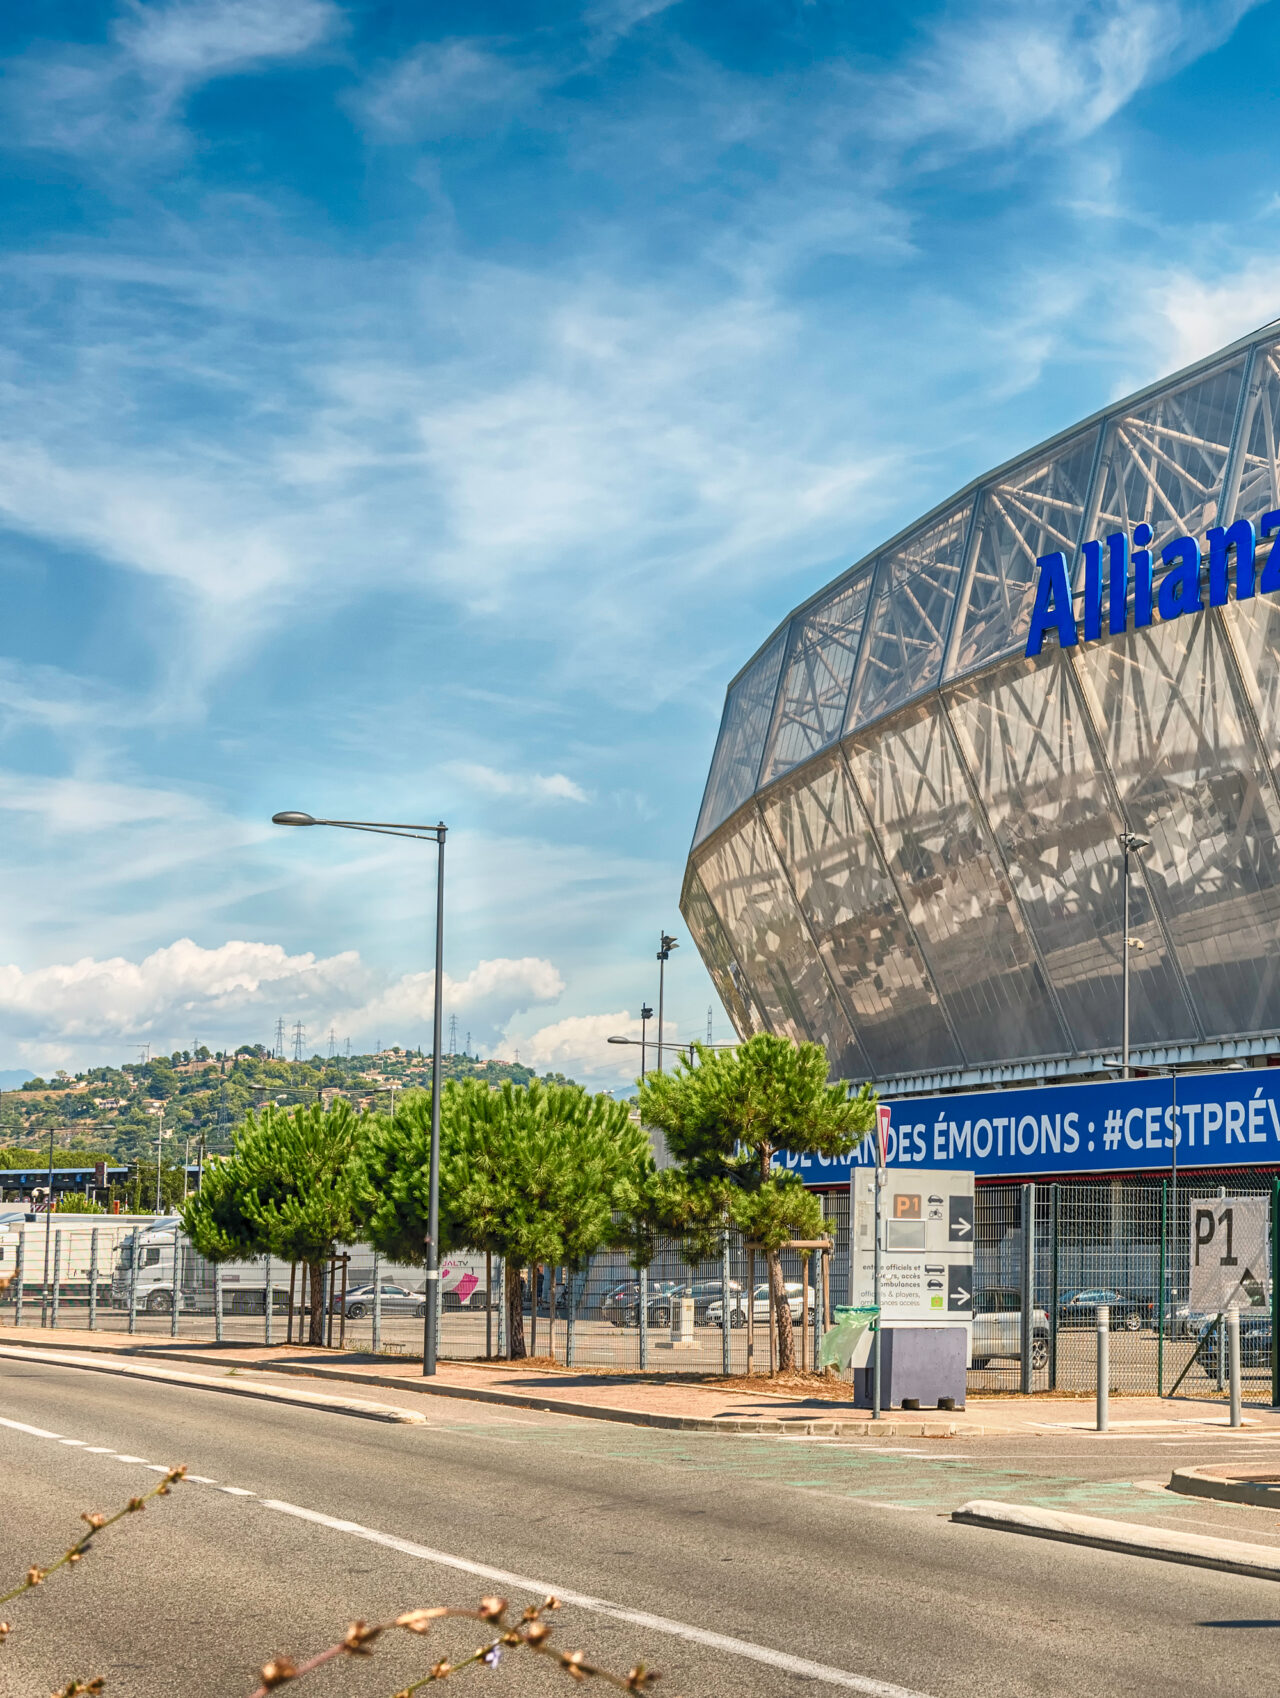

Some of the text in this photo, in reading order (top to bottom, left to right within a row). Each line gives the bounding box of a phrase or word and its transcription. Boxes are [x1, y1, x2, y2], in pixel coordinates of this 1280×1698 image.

[817, 1123, 926, 1168] ANDES
[934, 1111, 1080, 1160] ÉMOTIONS
[897, 1197, 919, 1217] P1
[1195, 1208, 1238, 1266] P1
